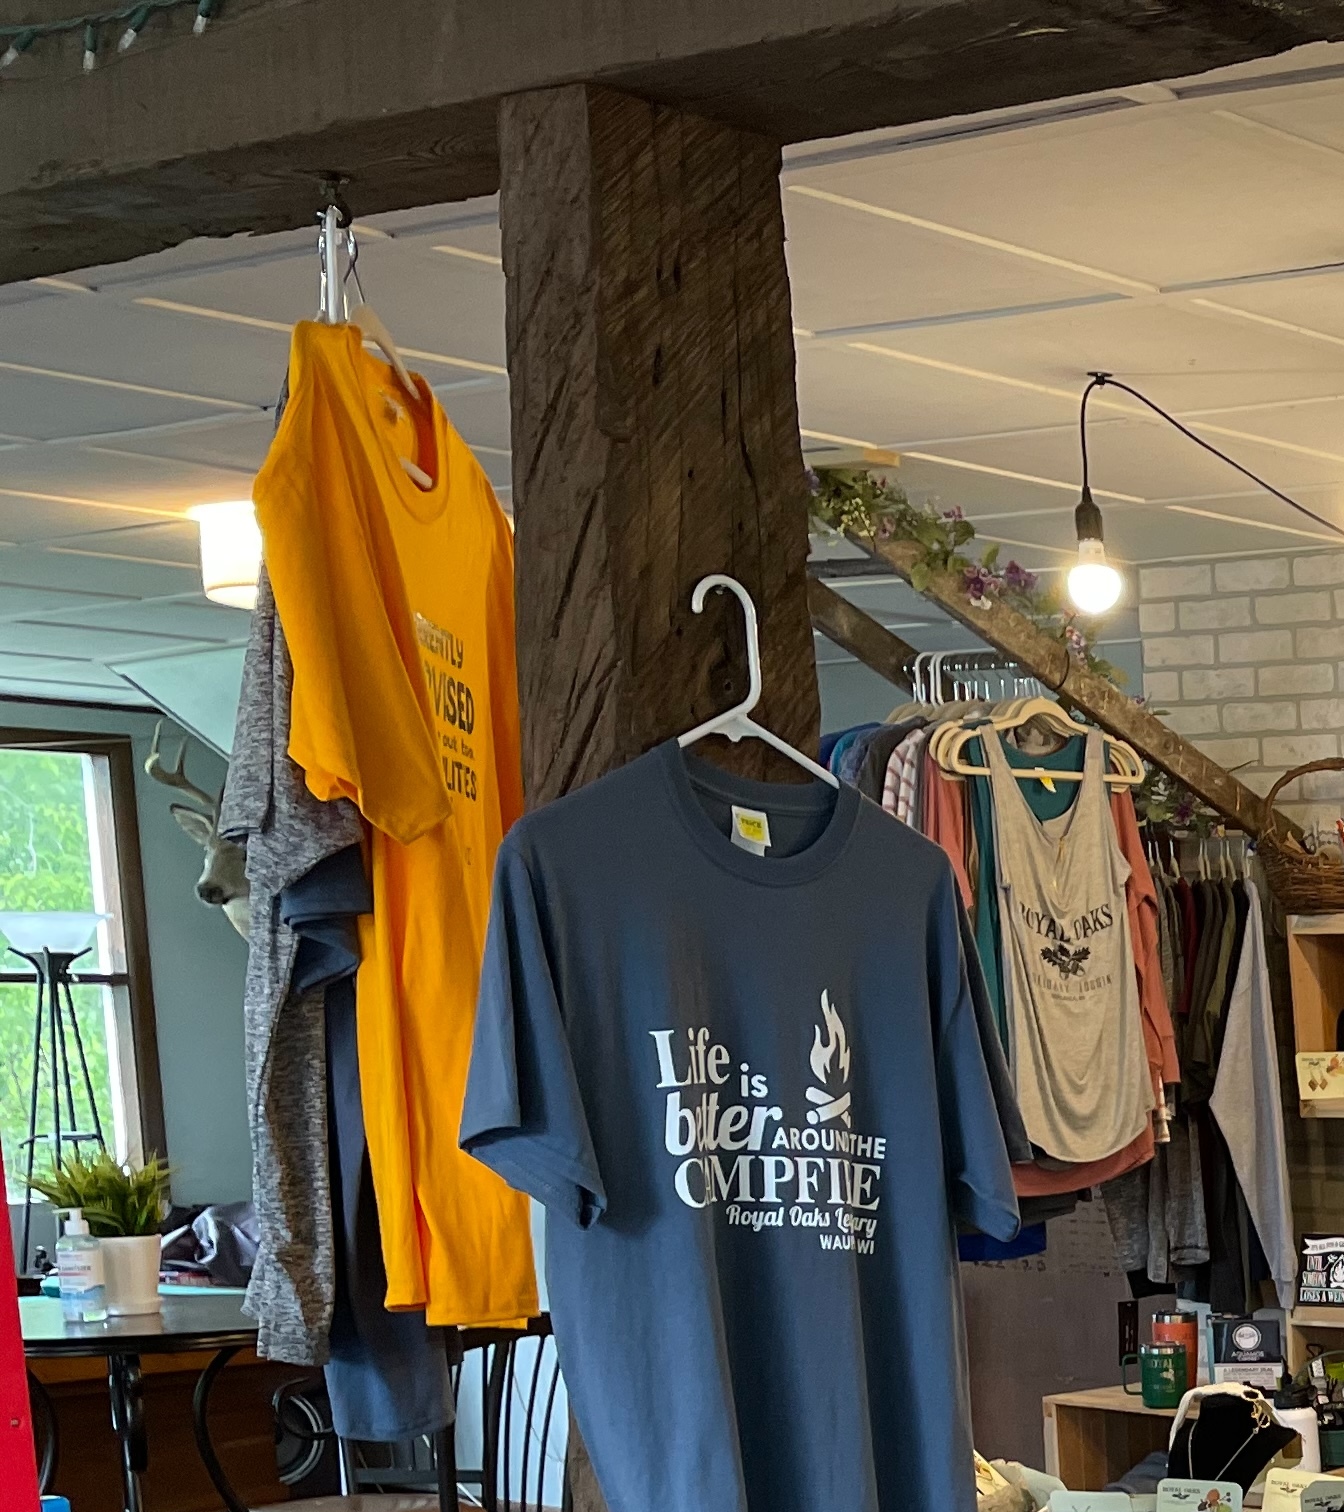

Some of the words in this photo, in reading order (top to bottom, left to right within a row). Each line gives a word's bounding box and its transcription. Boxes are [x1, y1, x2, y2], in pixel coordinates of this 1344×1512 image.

[1073, 903, 1114, 941] OAKS
[649, 1026, 730, 1089] Life
[740, 1062, 769, 1098] is
[726, 1204, 784, 1232] Royal
[789, 1206, 831, 1228] Oaks
